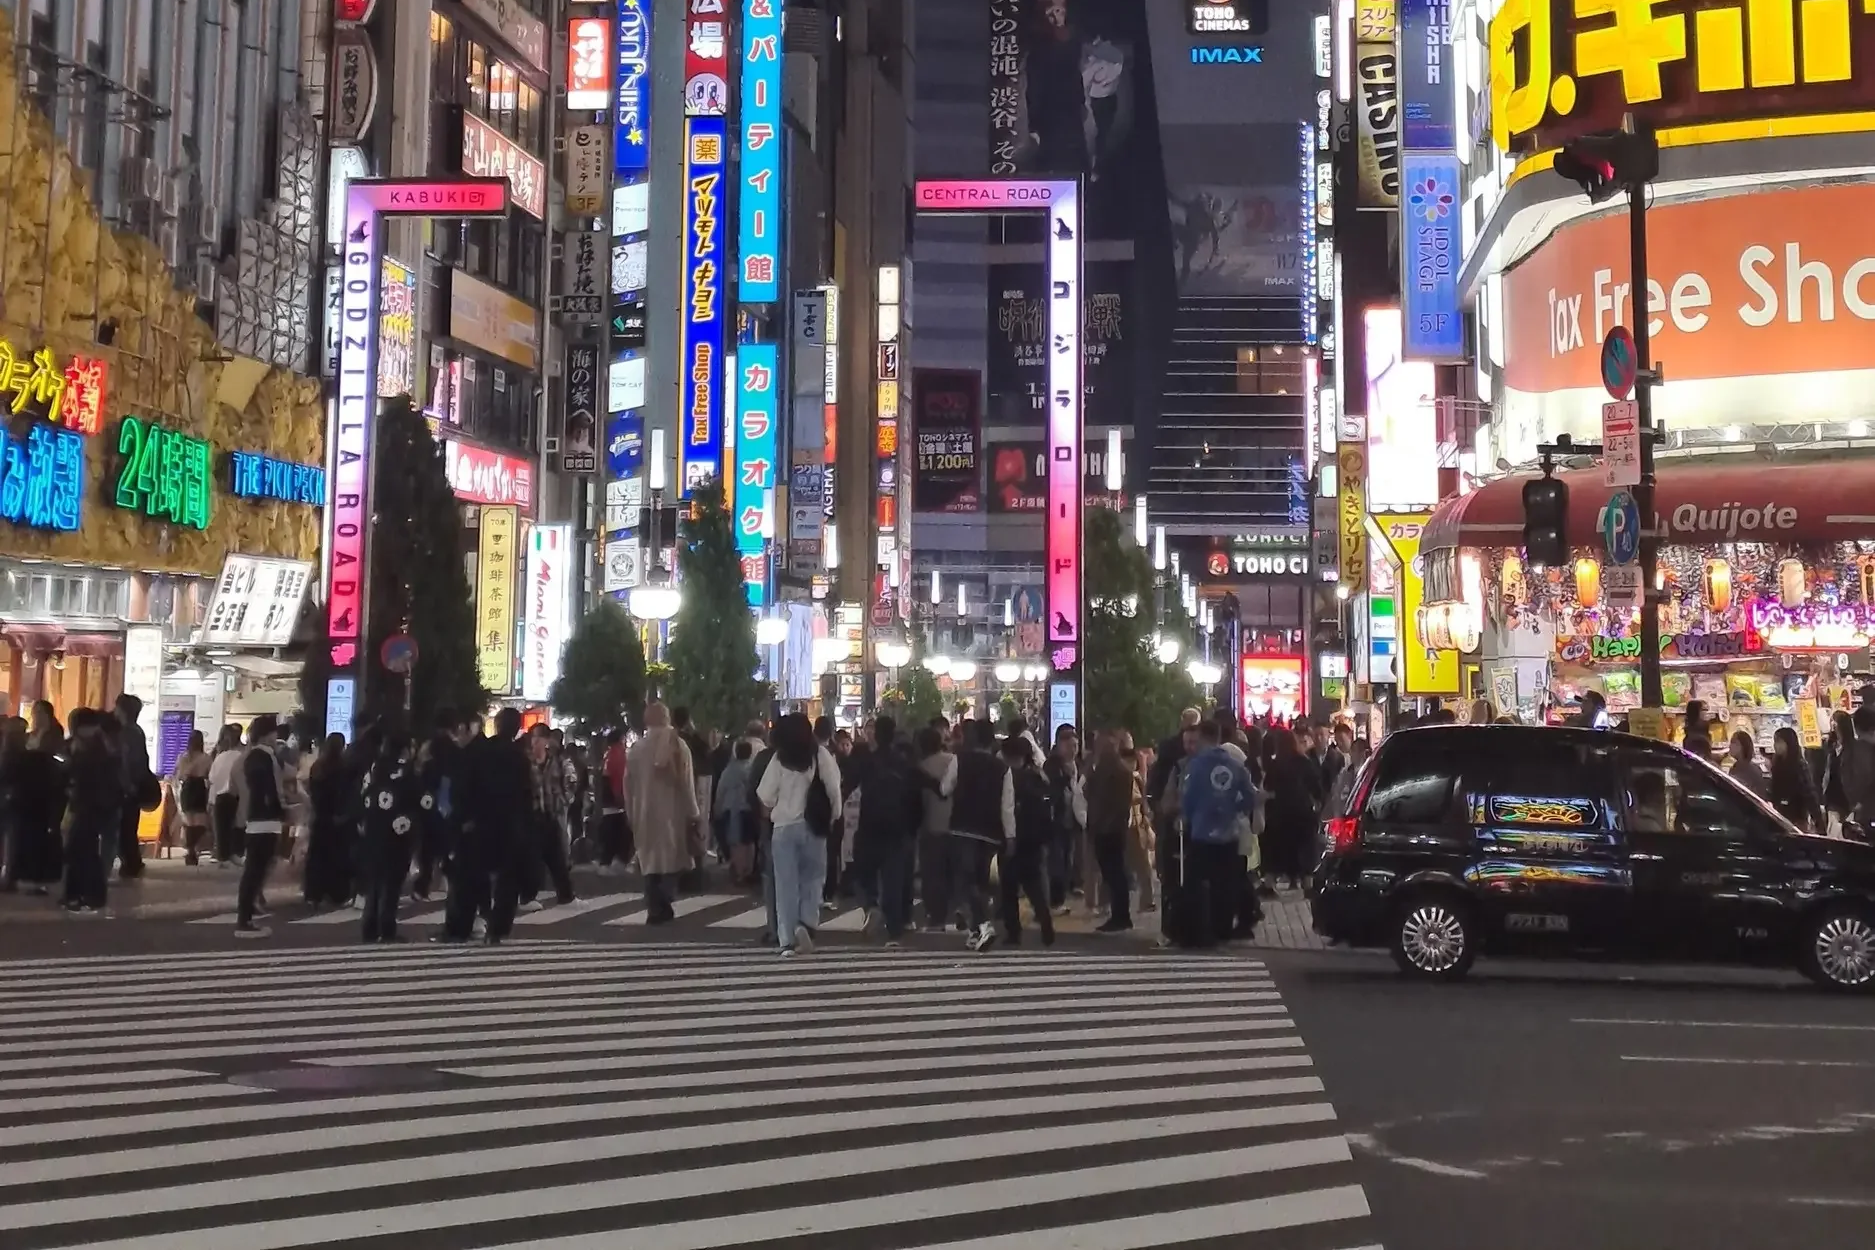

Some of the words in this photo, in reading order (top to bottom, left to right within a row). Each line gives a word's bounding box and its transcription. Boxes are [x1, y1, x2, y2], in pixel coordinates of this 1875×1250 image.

[1195, 8, 1235, 20] TOHO
[1195, 20, 1250, 31] CINEMAS
[618, 11, 642, 127] SHINJUKU
[1192, 47, 1262, 63] IMAX
[1359, 54, 1398, 197] CASINO
[390, 191, 486, 206] KABUKI町
[576, 197, 597, 211] 3F
[923, 188, 1000, 200] CENTRAL
[1007, 187, 1052, 200] ROAD
[691, 174, 720, 322] マツモトキヨシ
[1418, 226, 1434, 292] STAGE
[1434, 226, 1449, 282] IDOL
[1419, 313, 1449, 333] 5F
[1548, 286, 1584, 358] Tax
[338, 251, 370, 466] GODZILLA
[1052, 282, 1076, 575] ゴジラロード
[116, 417, 211, 531] 24時間
[1390, 523, 1424, 538] カラ
[1672, 501, 1798, 534] Quijote
[333, 492, 361, 596] ROAD
[1234, 558, 1282, 574] TOHO
[1289, 558, 1308, 574] CI
